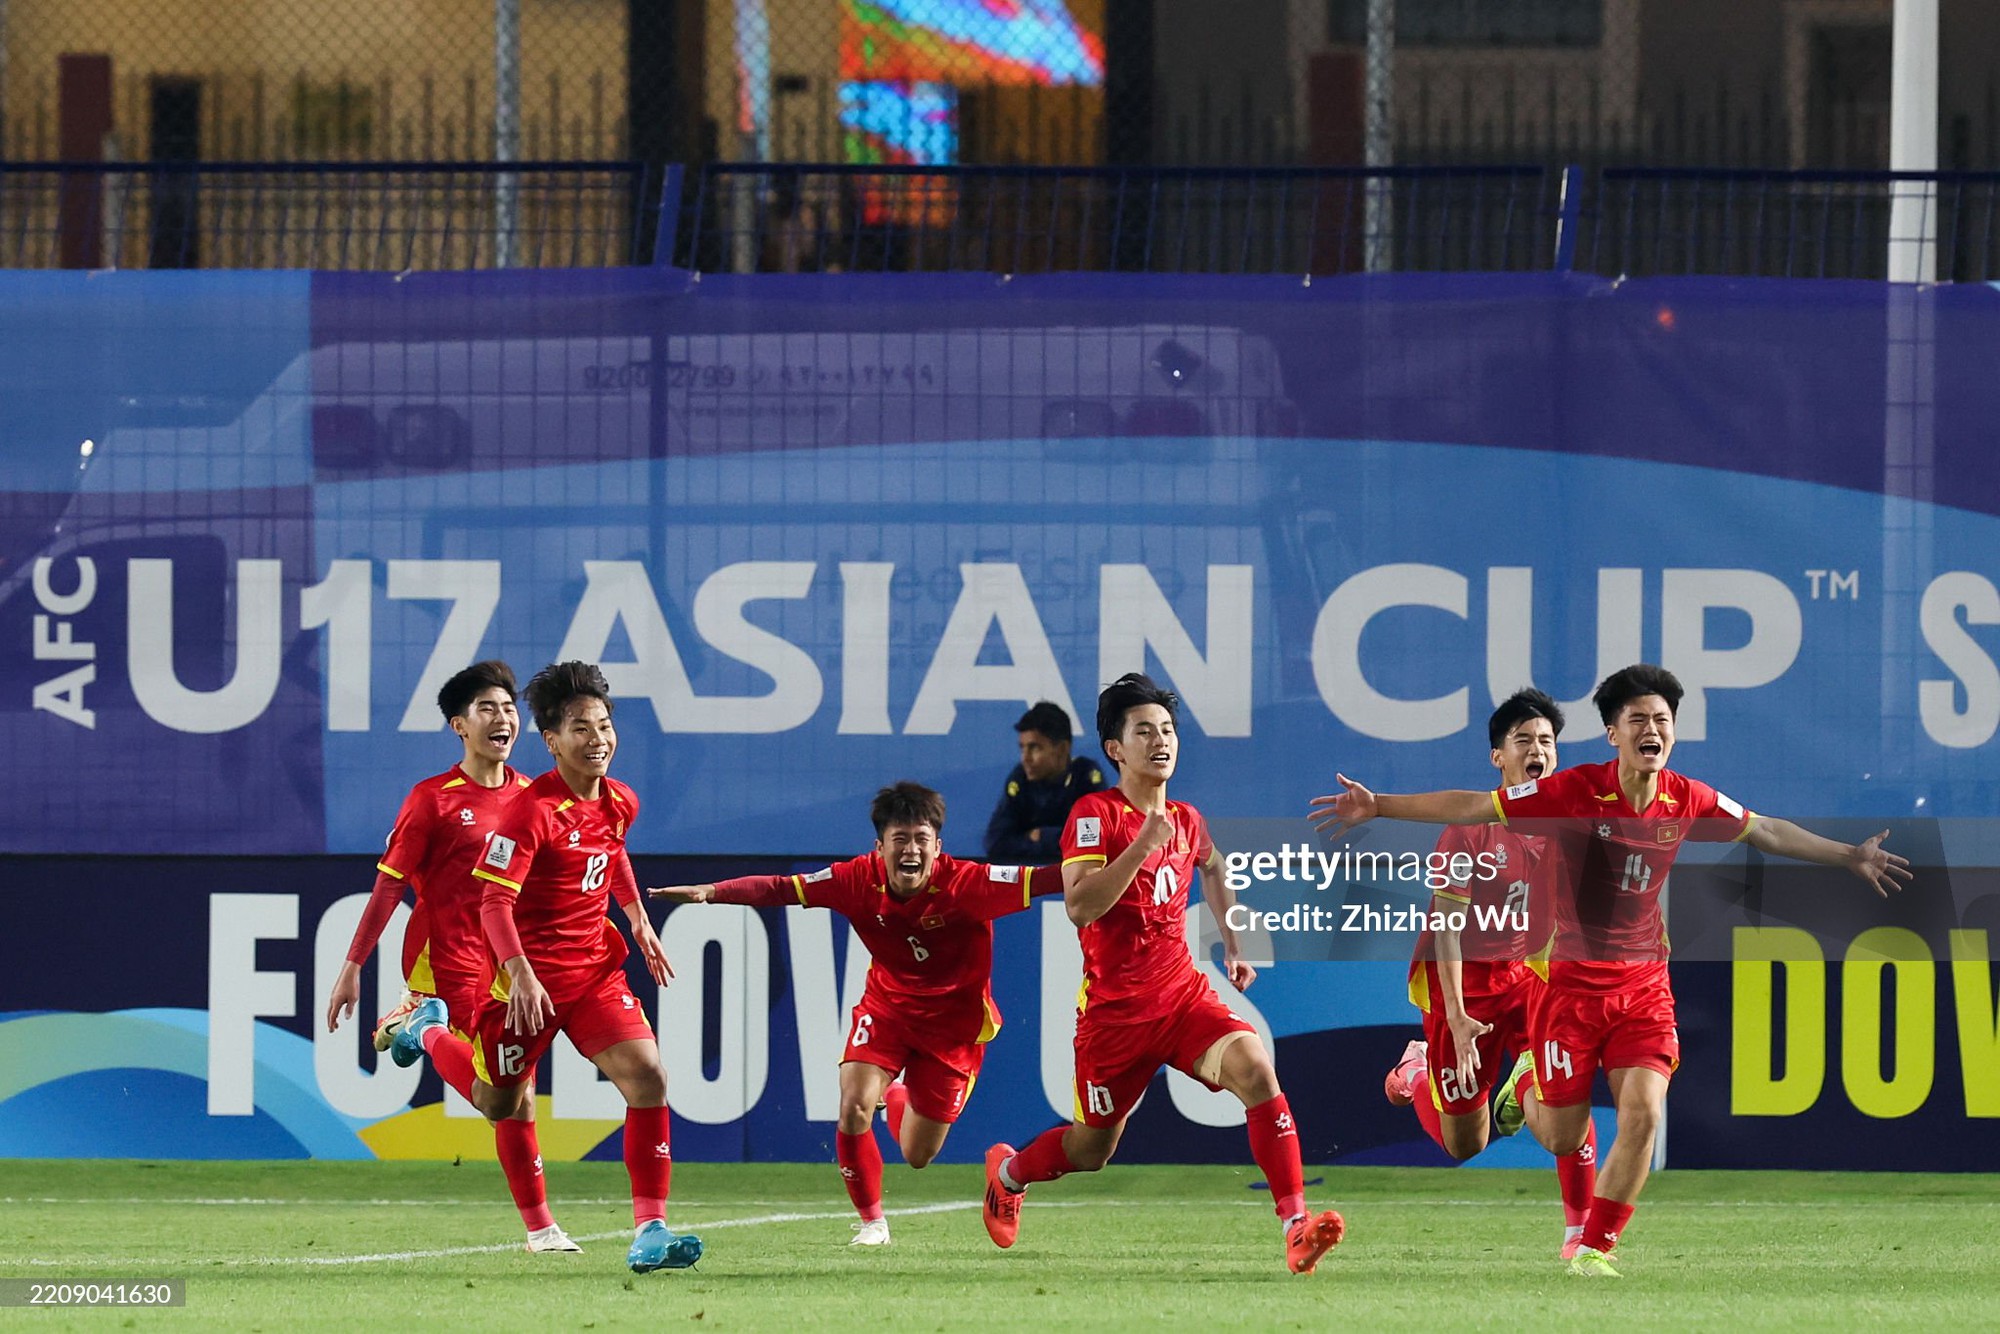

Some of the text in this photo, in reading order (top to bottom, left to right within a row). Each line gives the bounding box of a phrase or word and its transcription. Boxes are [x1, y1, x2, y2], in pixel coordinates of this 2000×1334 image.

[584, 364, 736, 388] 92002799
[33, 556, 97, 730] AFC
[128, 558, 501, 733] U17
[527, 560, 1254, 738] ASIAN
[1312, 563, 1802, 742] CUP
[582, 852, 609, 893] 12
[1153, 865, 1178, 906] 10
[1621, 853, 1651, 892] 14
[907, 935, 930, 962] 6
[852, 1013, 873, 1047] 6
[498, 1043, 526, 1076] 12
[1544, 1039, 1574, 1082] 14
[1086, 1080, 1115, 1116] 10
